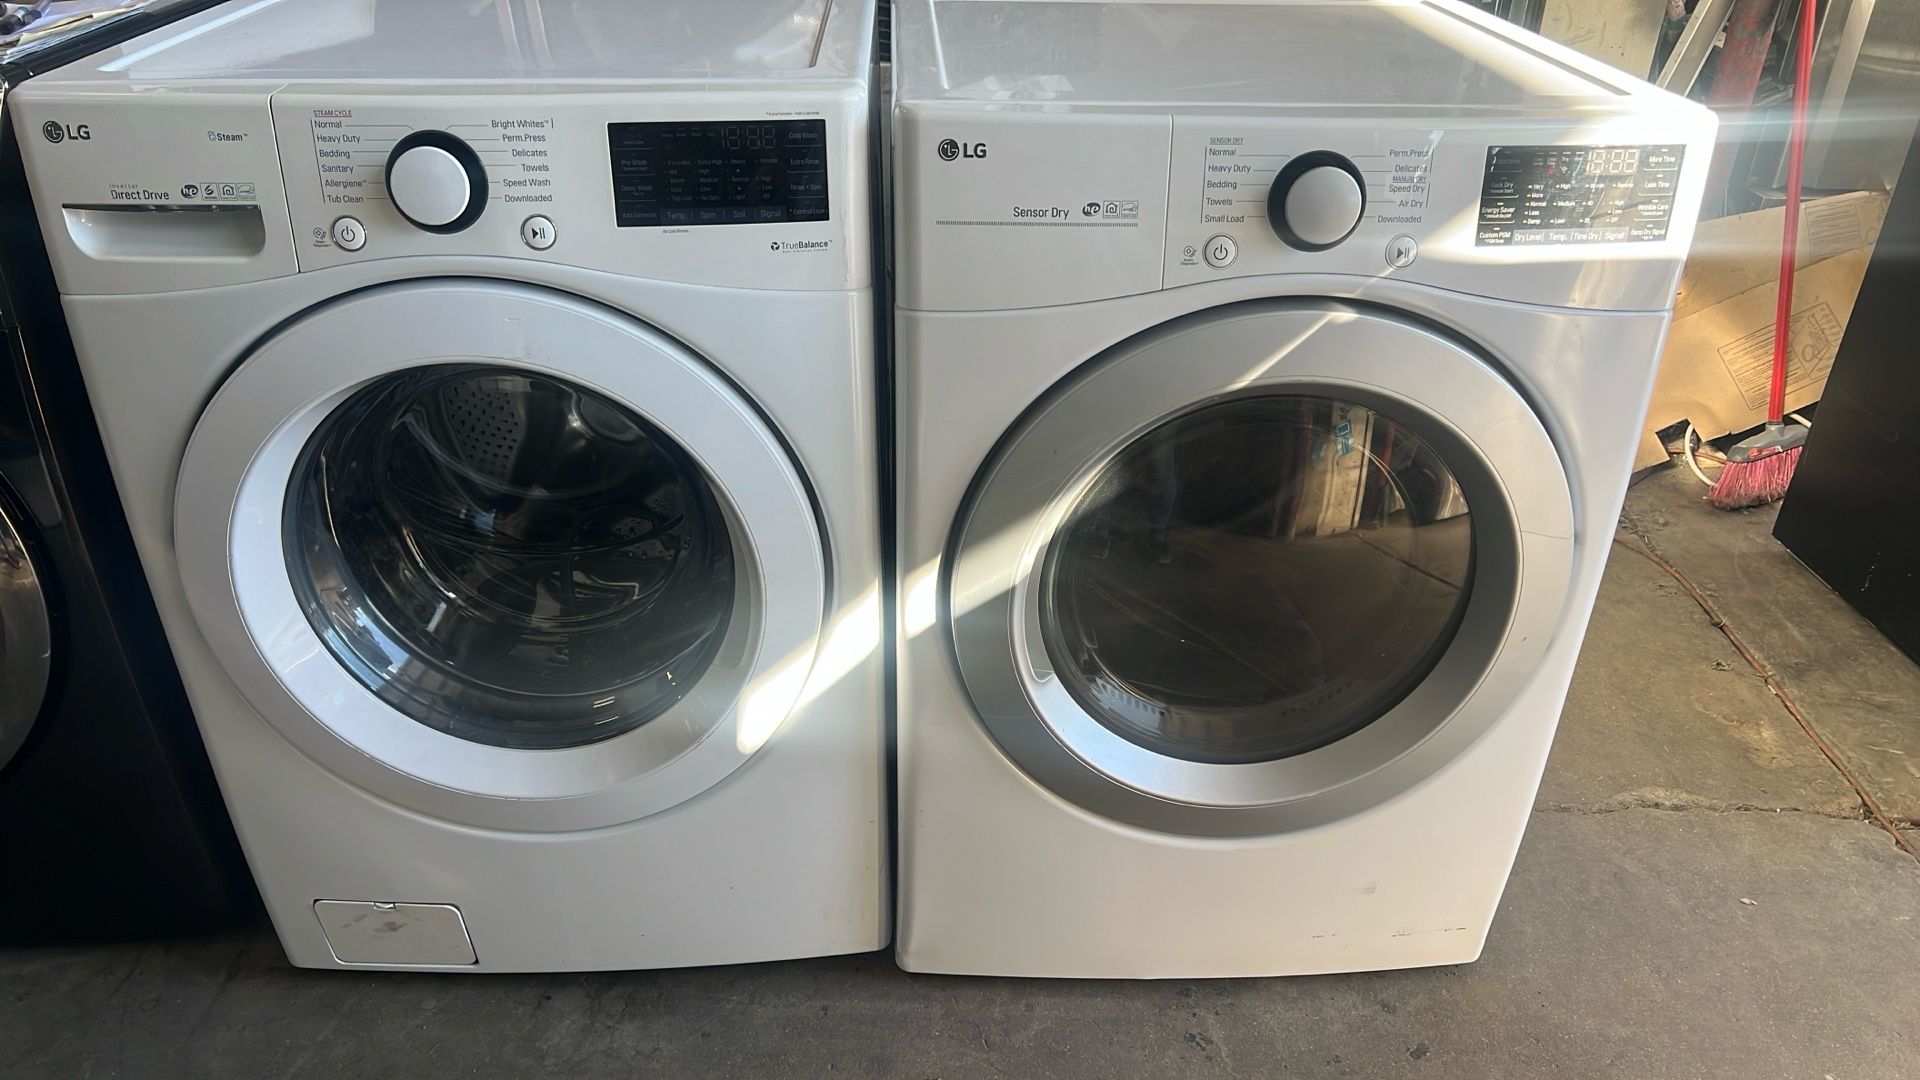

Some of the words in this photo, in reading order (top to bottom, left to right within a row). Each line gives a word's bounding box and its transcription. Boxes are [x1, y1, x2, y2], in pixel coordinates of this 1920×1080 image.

[314, 120, 342, 129] Normal
[491, 120, 515, 129] Bright
[66, 124, 90, 140] LG
[316, 134, 341, 144] Heavy
[342, 134, 360, 144] Duty
[319, 150, 350, 159] Bedding
[512, 149, 547, 157] Delicates
[963, 143, 987, 158] LG
[1209, 148, 1236, 156] Normal
[322, 164, 354, 174] Sanitary
[522, 164, 549, 172] Towels
[1208, 164, 1231, 174] Heavy
[1233, 164, 1251, 174] Duty
[503, 179, 527, 188] Speed
[1207, 180, 1237, 190] Bedding
[1389, 184, 1411, 194] Speed
[1412, 184, 1425, 193] Dry
[110, 190, 142, 200] Direct
[143, 190, 170, 200] Drive
[327, 195, 341, 203] Tub
[343, 195, 364, 203] Clean
[505, 194, 552, 202] Downloaded
[1206, 197, 1232, 206] Towels
[1410, 199, 1424, 208] Dry
[700, 211, 716, 220] Spin
[733, 210, 746, 218] Soil
[760, 209, 782, 218] Signal
[1013, 206, 1048, 218] Sensor
[1051, 207, 1070, 220] Dry
[1205, 215, 1225, 223] Small
[1226, 214, 1244, 223] Load
[1377, 215, 1422, 223] Downloaded
[1515, 233, 1526, 242] Dry
[1587, 233, 1599, 242] Dry
[1604, 232, 1625, 242] Signal
